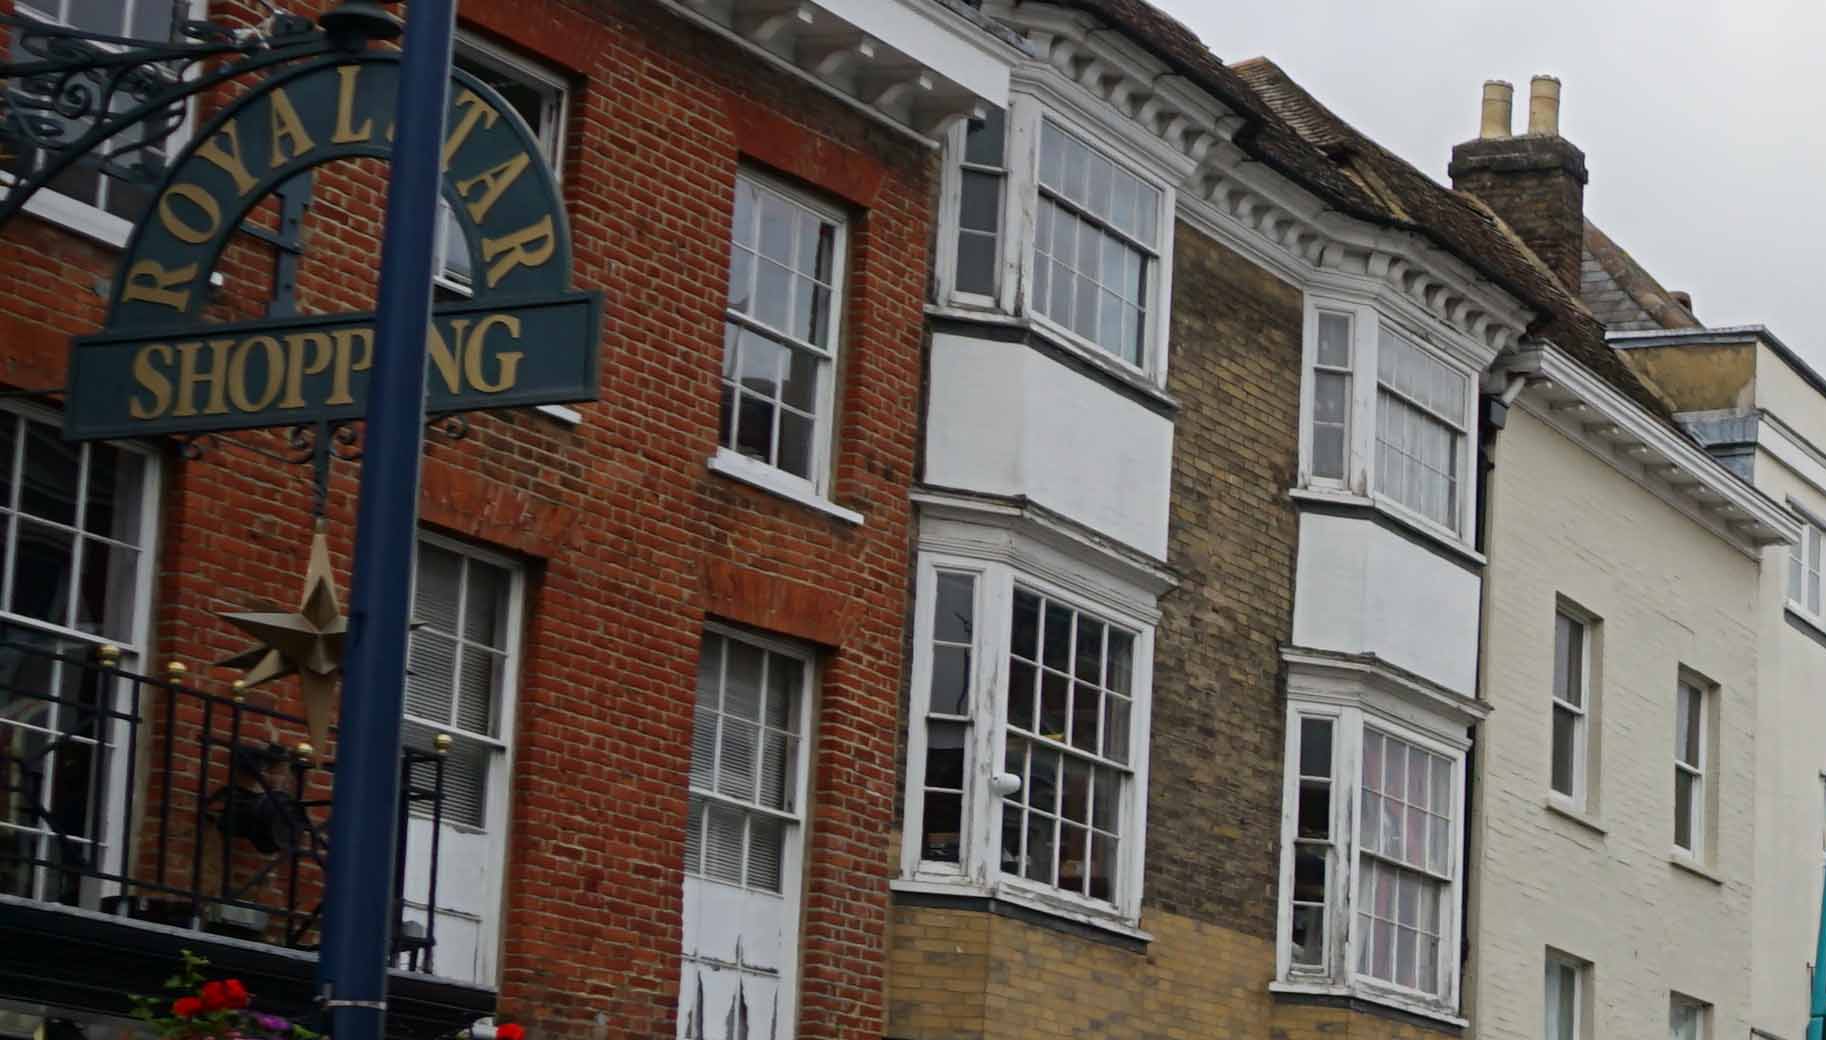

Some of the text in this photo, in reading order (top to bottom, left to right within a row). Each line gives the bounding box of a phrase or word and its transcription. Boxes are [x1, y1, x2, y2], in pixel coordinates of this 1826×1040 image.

[124, 65, 556, 313] ROYAL TAR
[130, 313, 525, 421] SHOPPNG
